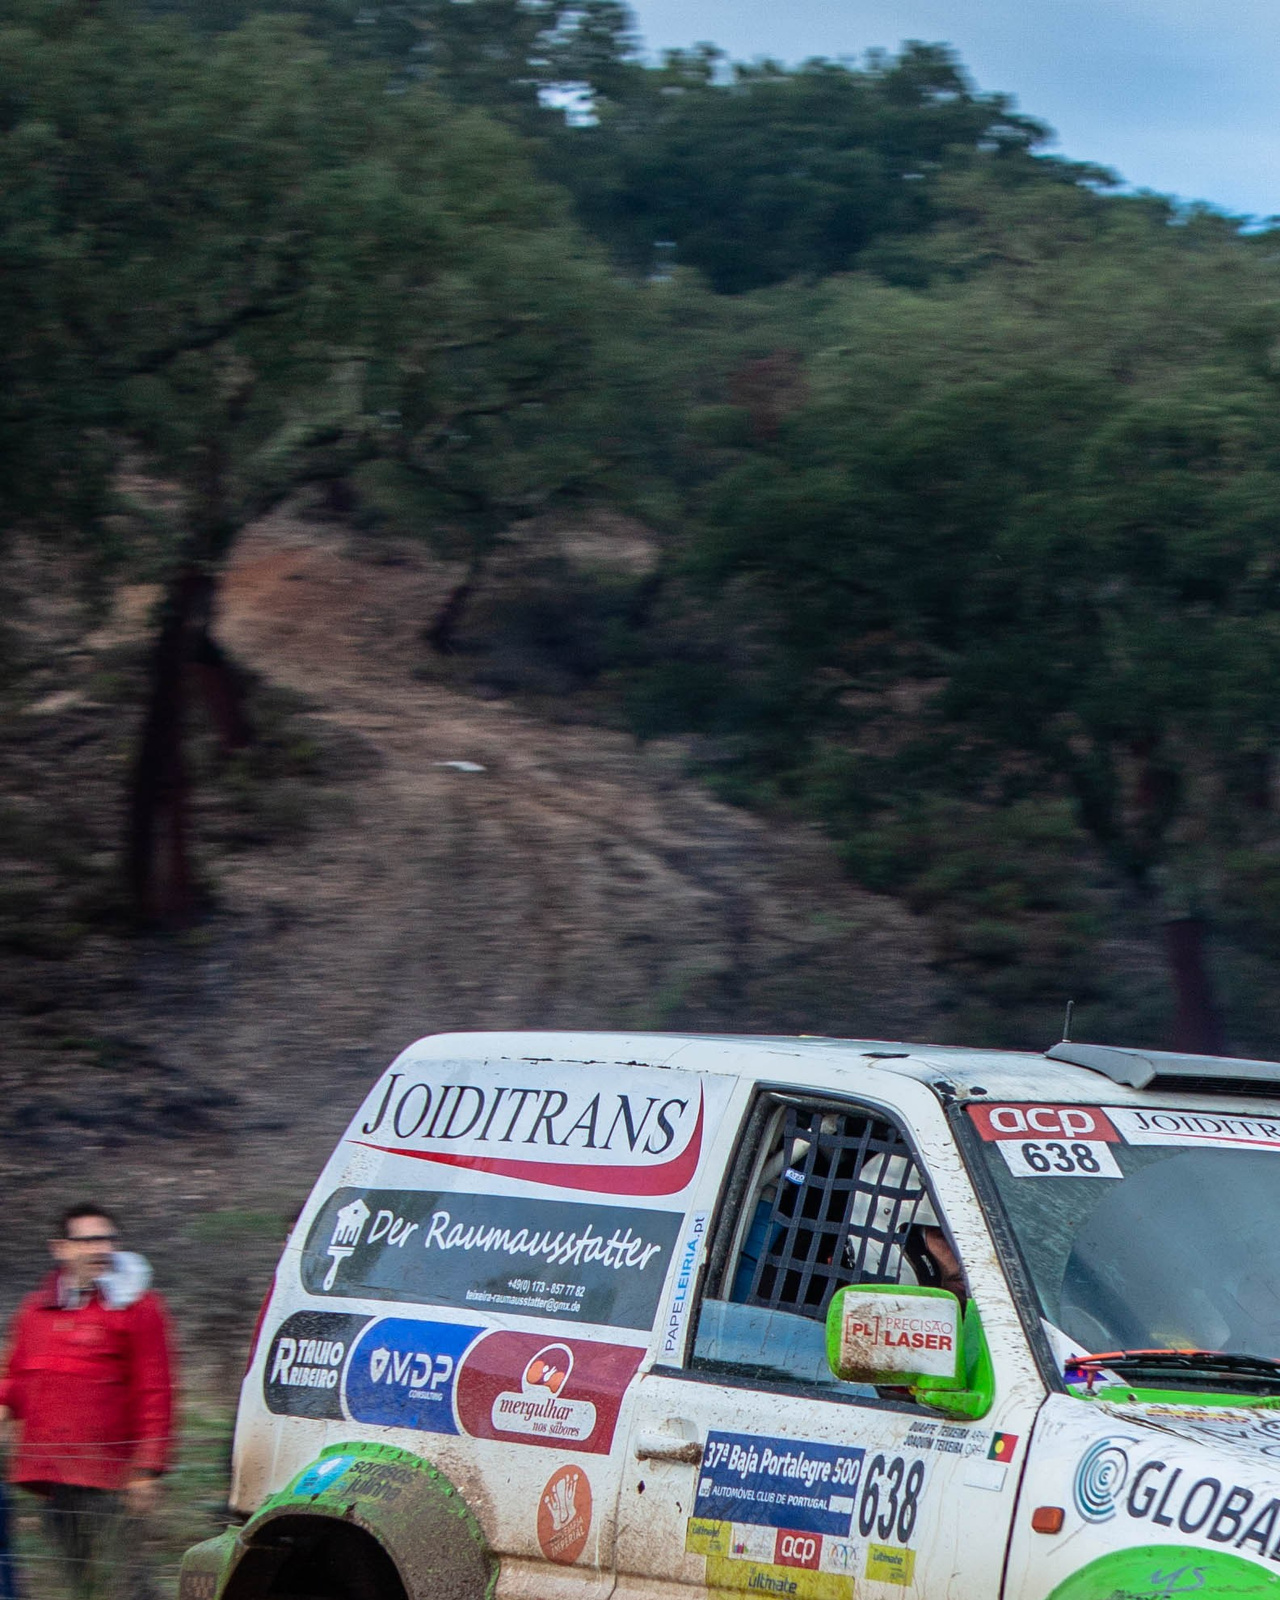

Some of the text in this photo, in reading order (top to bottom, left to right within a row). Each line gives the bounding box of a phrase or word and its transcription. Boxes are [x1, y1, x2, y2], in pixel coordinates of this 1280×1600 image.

[362, 1073, 689, 1155] JOIDITRANS
[989, 1107, 1096, 1138] acp
[1021, 1142, 1101, 1173] 638
[367, 1210, 662, 1270] Der Raumausstatter
[532, 1281, 546, 1293] 173
[565, 1284, 575, 1296] 77
[575, 1286, 586, 1297] 82
[665, 1216, 706, 1351] PAPELEIRIA.pt
[886, 1317, 953, 1334] PRECISÃO
[884, 1331, 952, 1351] LASER
[289, 1366, 338, 1389] RIBEIRO
[499, 1398, 573, 1421] mergulhar
[532, 1422, 547, 1432] nos
[728, 1444, 759, 1479] Baja
[759, 1448, 831, 1487] Portalegre
[831, 1457, 861, 1485] 500
[712, 1485, 756, 1501] AUTOMÓVEL
[756, 1491, 776, 1502] CLUB
[776, 1493, 786, 1505] DE
[787, 1495, 828, 1510] PORTUGAL
[859, 1454, 925, 1543] 638
[781, 1535, 816, 1564] acp
